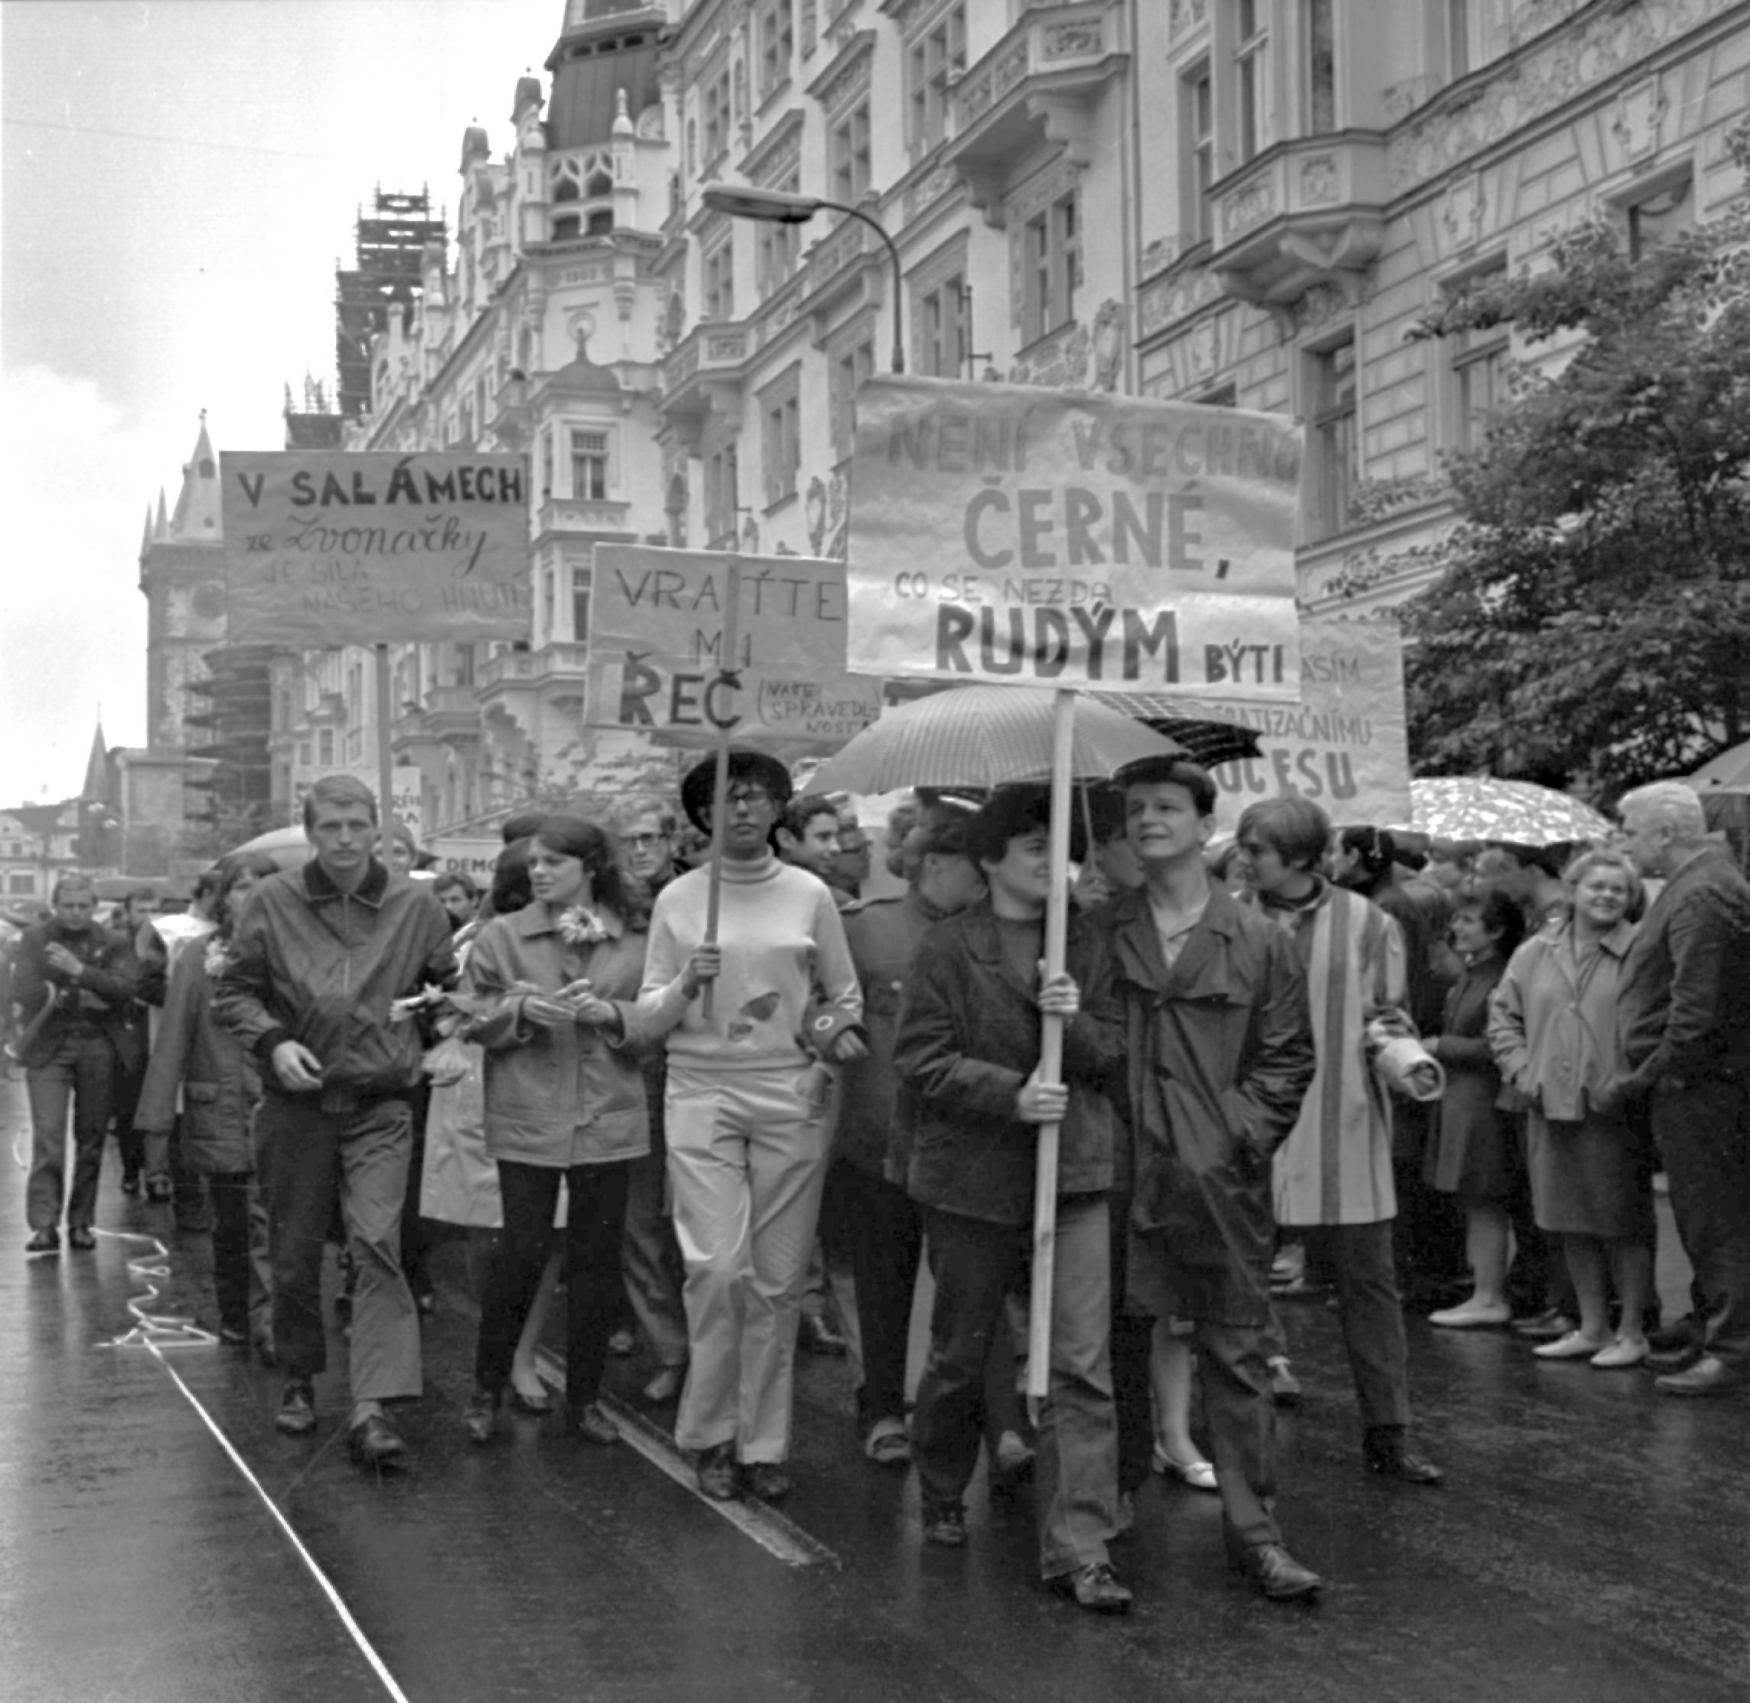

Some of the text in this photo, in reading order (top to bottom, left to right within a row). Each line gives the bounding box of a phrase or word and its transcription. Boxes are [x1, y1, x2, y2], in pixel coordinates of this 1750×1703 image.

[237, 456, 521, 508] V SALÁMECH
[247, 534, 273, 551] ze
[261, 560, 295, 584] JE
[894, 570, 929, 599] CO
[938, 573, 982, 602] SE
[936, 601, 1180, 684] RUDÝM
[1204, 638, 1284, 684] BÝTI
[619, 651, 744, 729] ŘEČ
